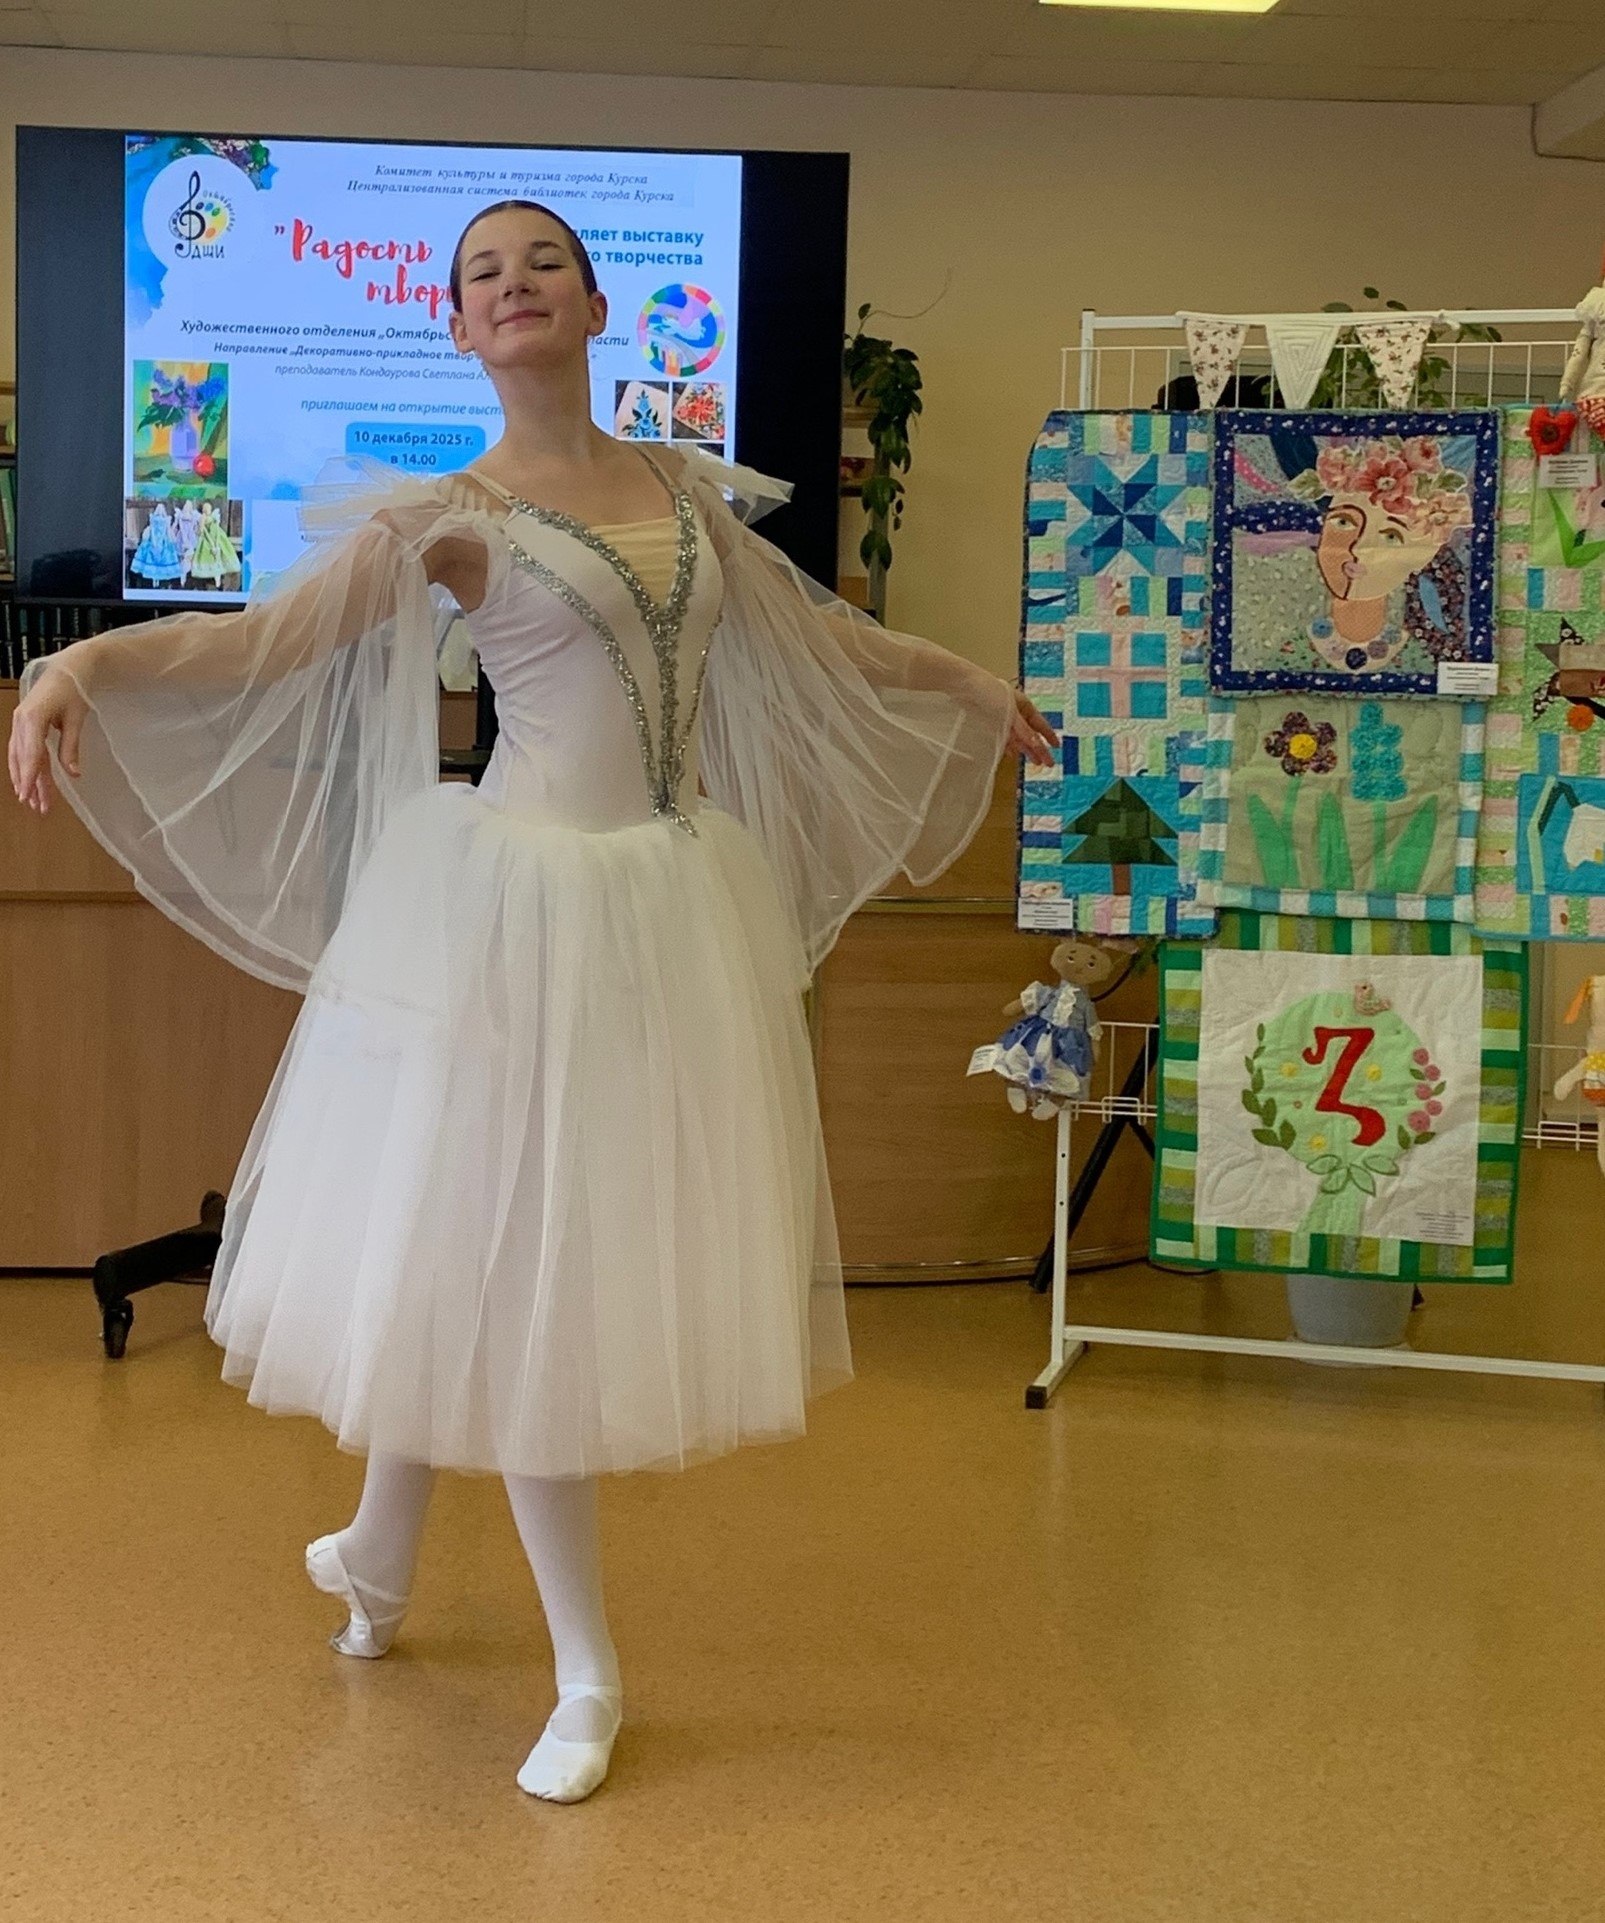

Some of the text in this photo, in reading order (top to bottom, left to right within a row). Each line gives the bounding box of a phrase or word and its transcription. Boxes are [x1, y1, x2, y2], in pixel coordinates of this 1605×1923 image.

[375, 165, 432, 177] Комитет
[437, 169, 495, 182] культуры
[511, 172, 561, 183] туризма
[565, 173, 604, 185] города
[608, 173, 648, 186] Курска
[347, 180, 675, 203] Централизованная система библиотек города Курска
[574, 229, 704, 248] ляет выставку
[191, 245, 225, 259] ДШИ
[606, 251, 703, 268] творчества
[180, 320, 300, 336] Художественного
[303, 324, 377, 338] отделения
[214, 342, 289, 355] Направление
[275, 363, 357, 377] преподаватель
[359, 366, 421, 380] Кондаурова
[422, 368, 475, 380] Светлана
[301, 400, 379, 412] приглашаем
[381, 403, 396, 412] на
[399, 404, 467, 415] открытие
[355, 430, 474, 446] 10 декабря 2025 г.
[391, 453, 437, 466] в 14.00
